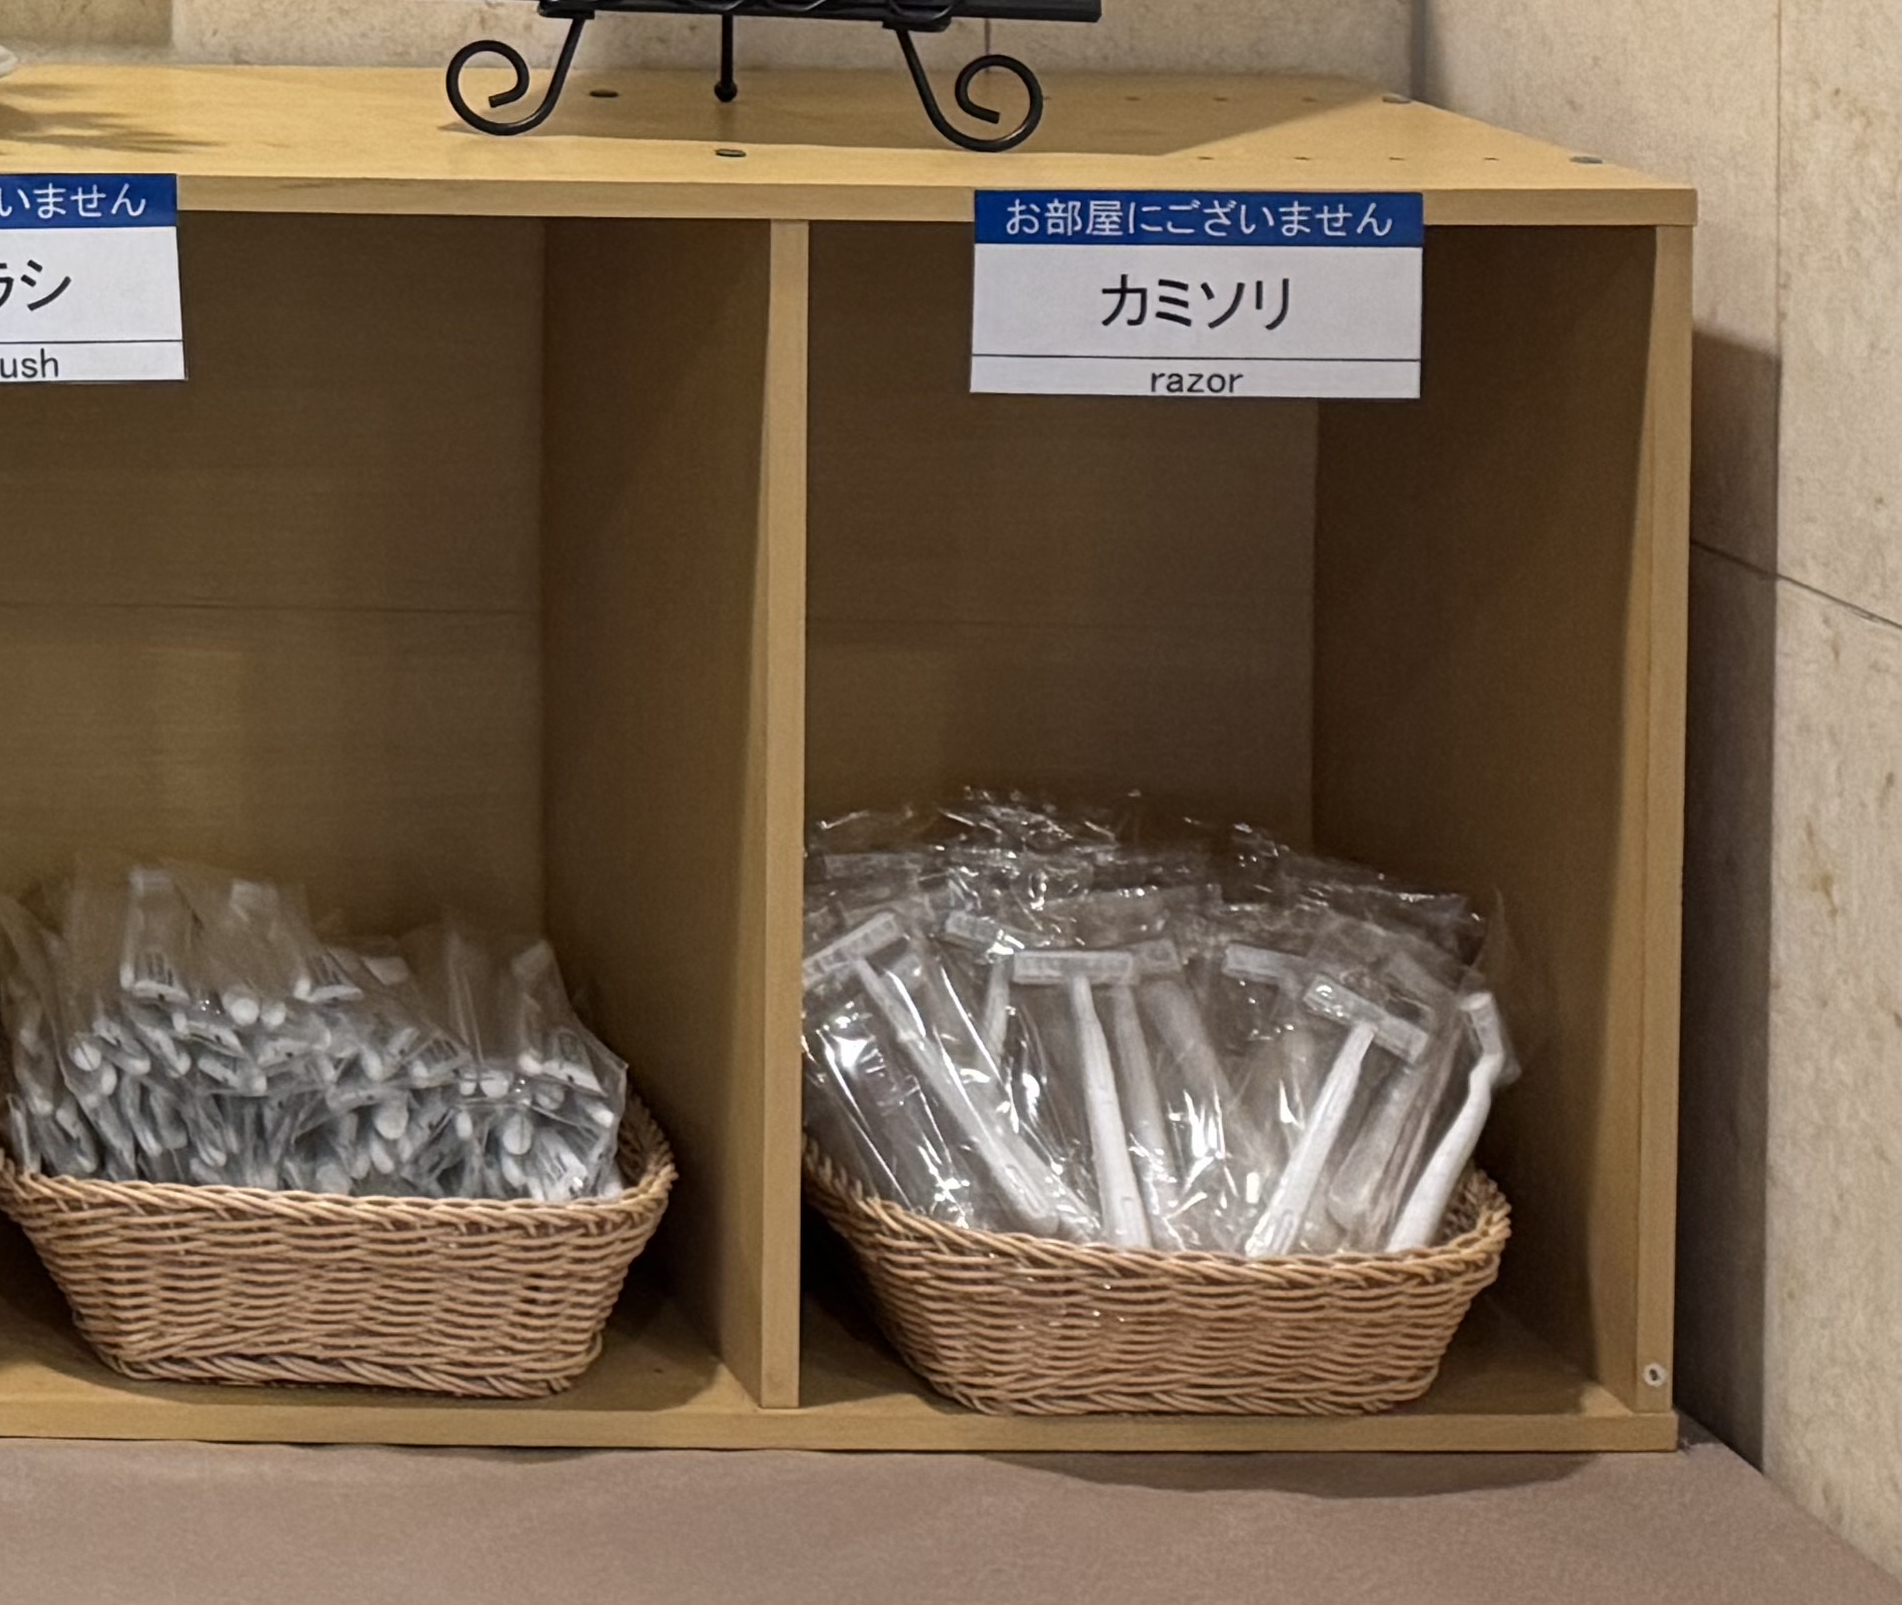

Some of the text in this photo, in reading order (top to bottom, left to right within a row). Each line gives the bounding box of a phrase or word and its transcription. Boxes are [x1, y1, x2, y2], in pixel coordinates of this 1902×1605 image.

[1005, 198, 1393, 237] お部屋にございません
[1101, 273, 1290, 330] カミソリ
[1150, 370, 1243, 393] razor
